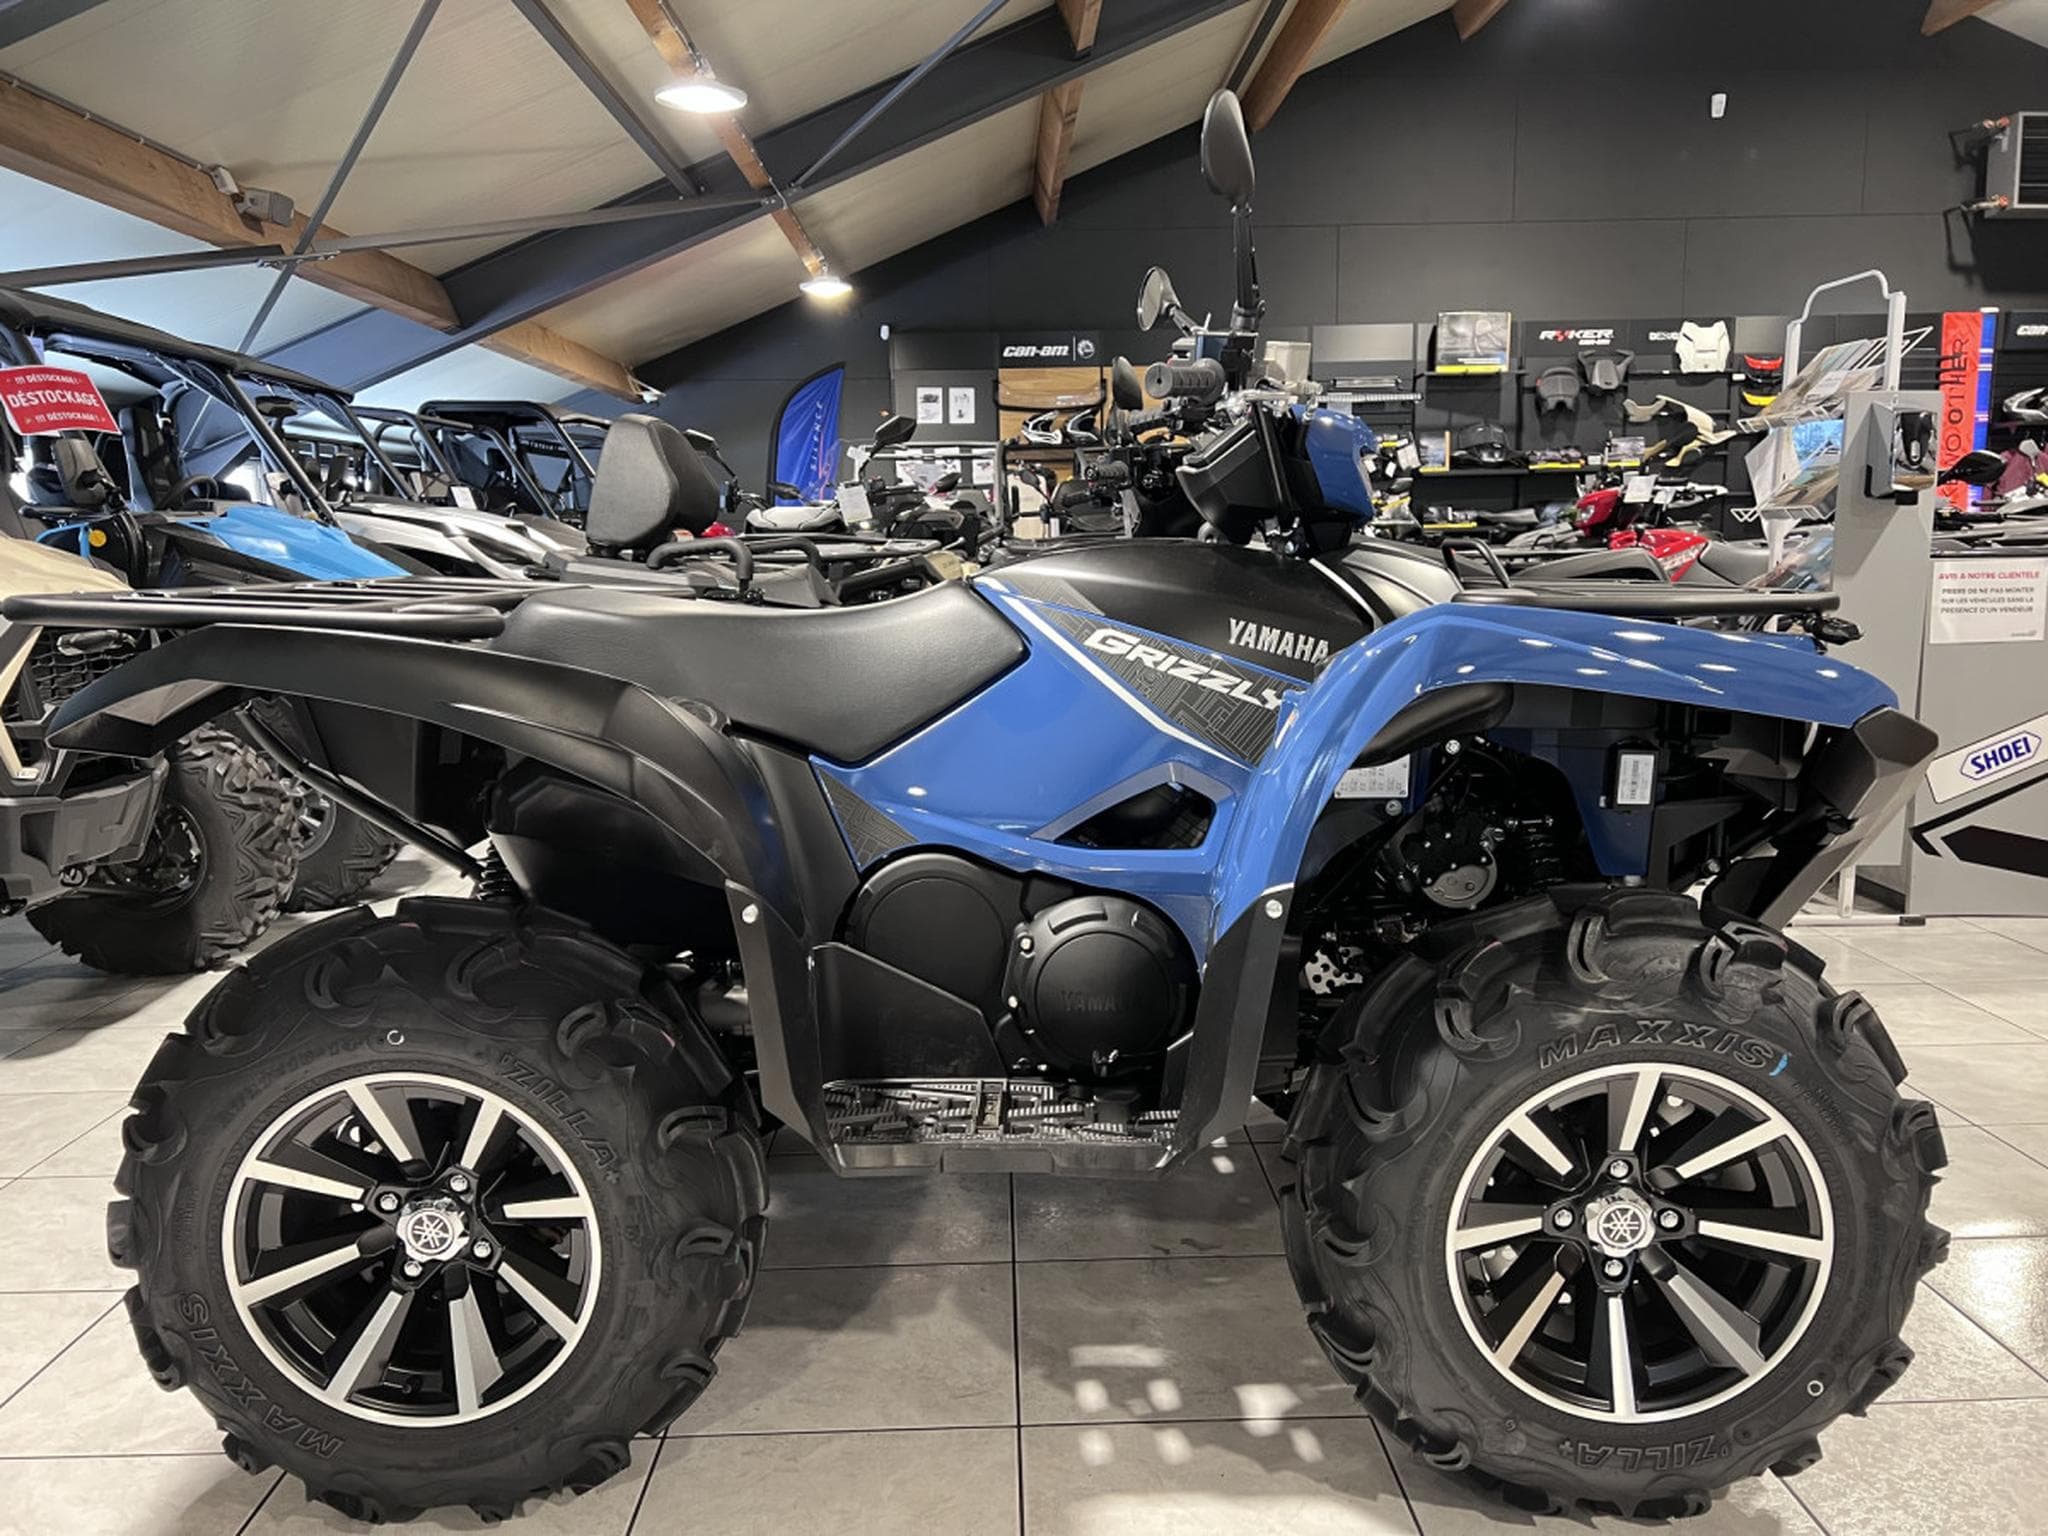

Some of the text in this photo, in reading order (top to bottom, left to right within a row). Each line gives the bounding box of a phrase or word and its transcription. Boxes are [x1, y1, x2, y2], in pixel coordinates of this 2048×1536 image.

[1002, 345, 1070, 358] can-am
[1539, 329, 1614, 341] RYKER
[7, 389, 100, 408] DÉSTOCKAGE
[1948, 338, 1970, 425] OTHER
[1998, 571, 2040, 579] CLIENTELE
[1229, 617, 1329, 664] YAMAHA
[1083, 627, 1283, 710] GRIZZLY
[1970, 737, 2031, 774] SHOEI
[1538, 1020, 1774, 1069] MAXXIS
[179, 1292, 345, 1459] MAXXIS
